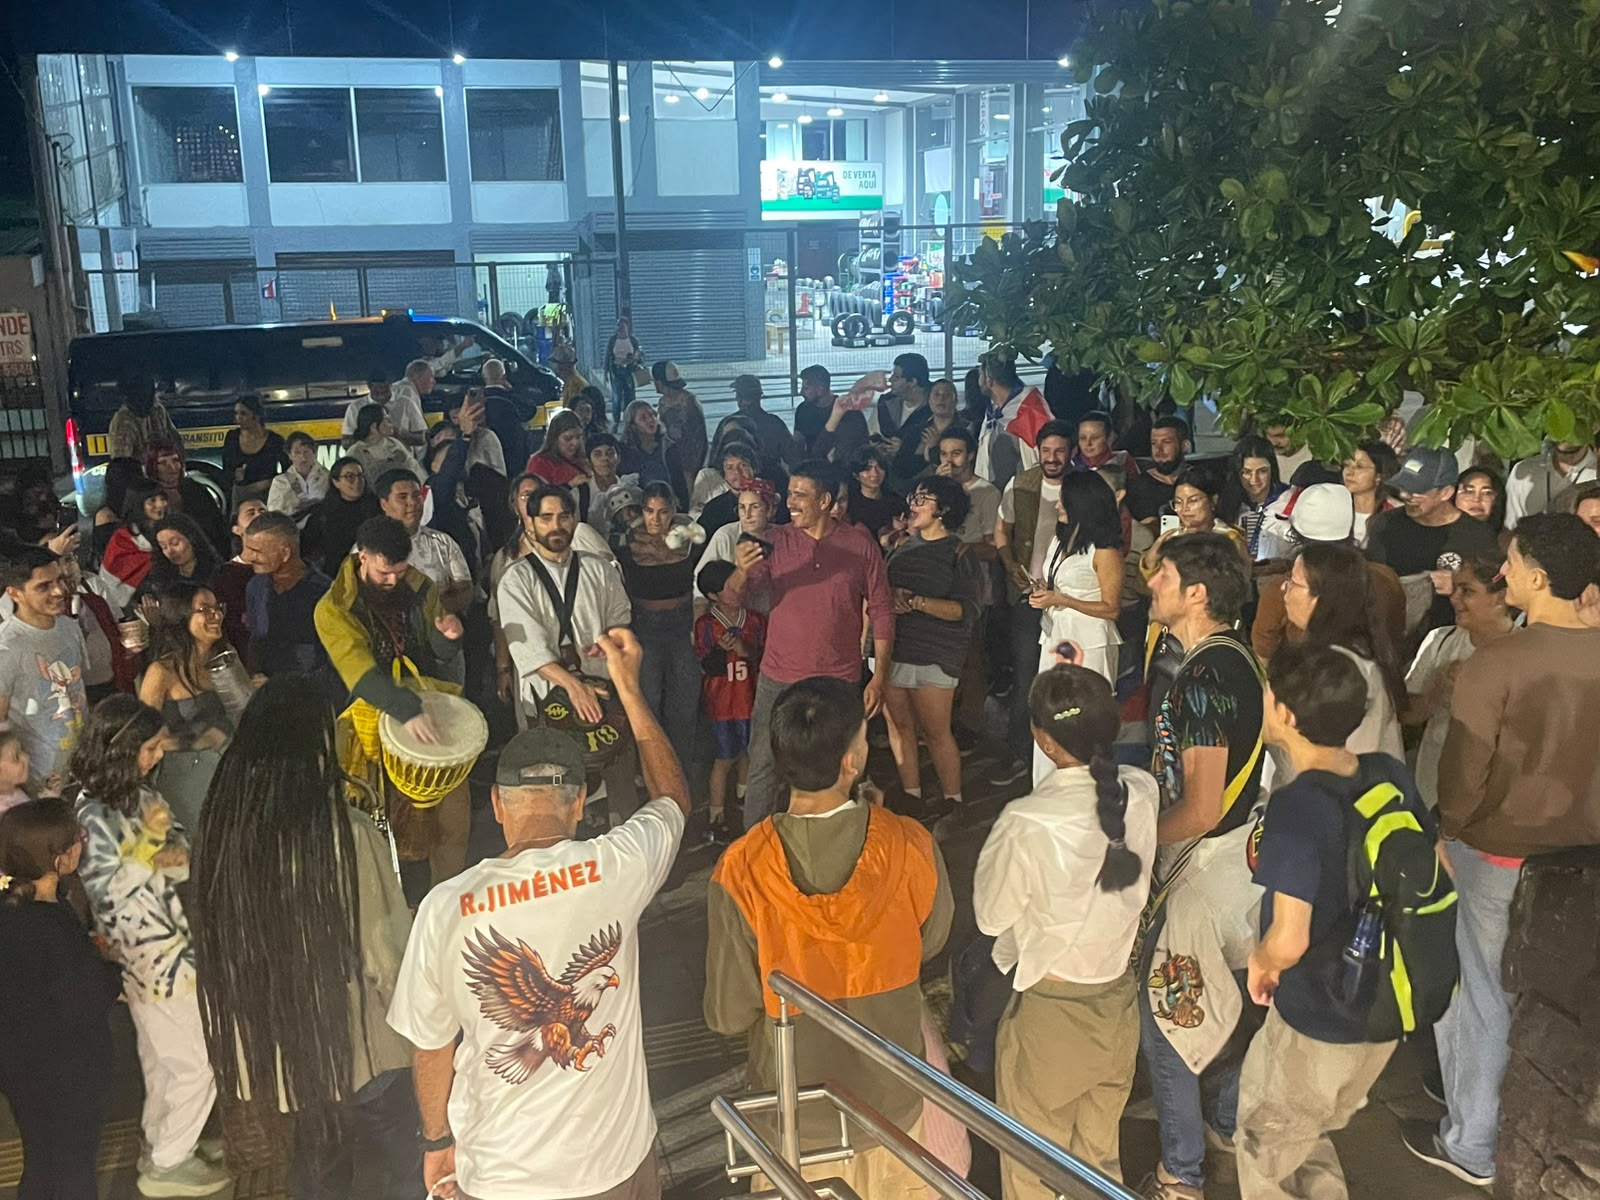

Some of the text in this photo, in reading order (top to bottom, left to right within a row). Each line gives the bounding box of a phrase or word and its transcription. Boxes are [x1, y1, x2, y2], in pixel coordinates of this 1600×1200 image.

[842, 170, 876, 179] DE VENTA
[727, 660, 748, 682] 15
[459, 860, 601, 917] R.JIMÉNEZ
